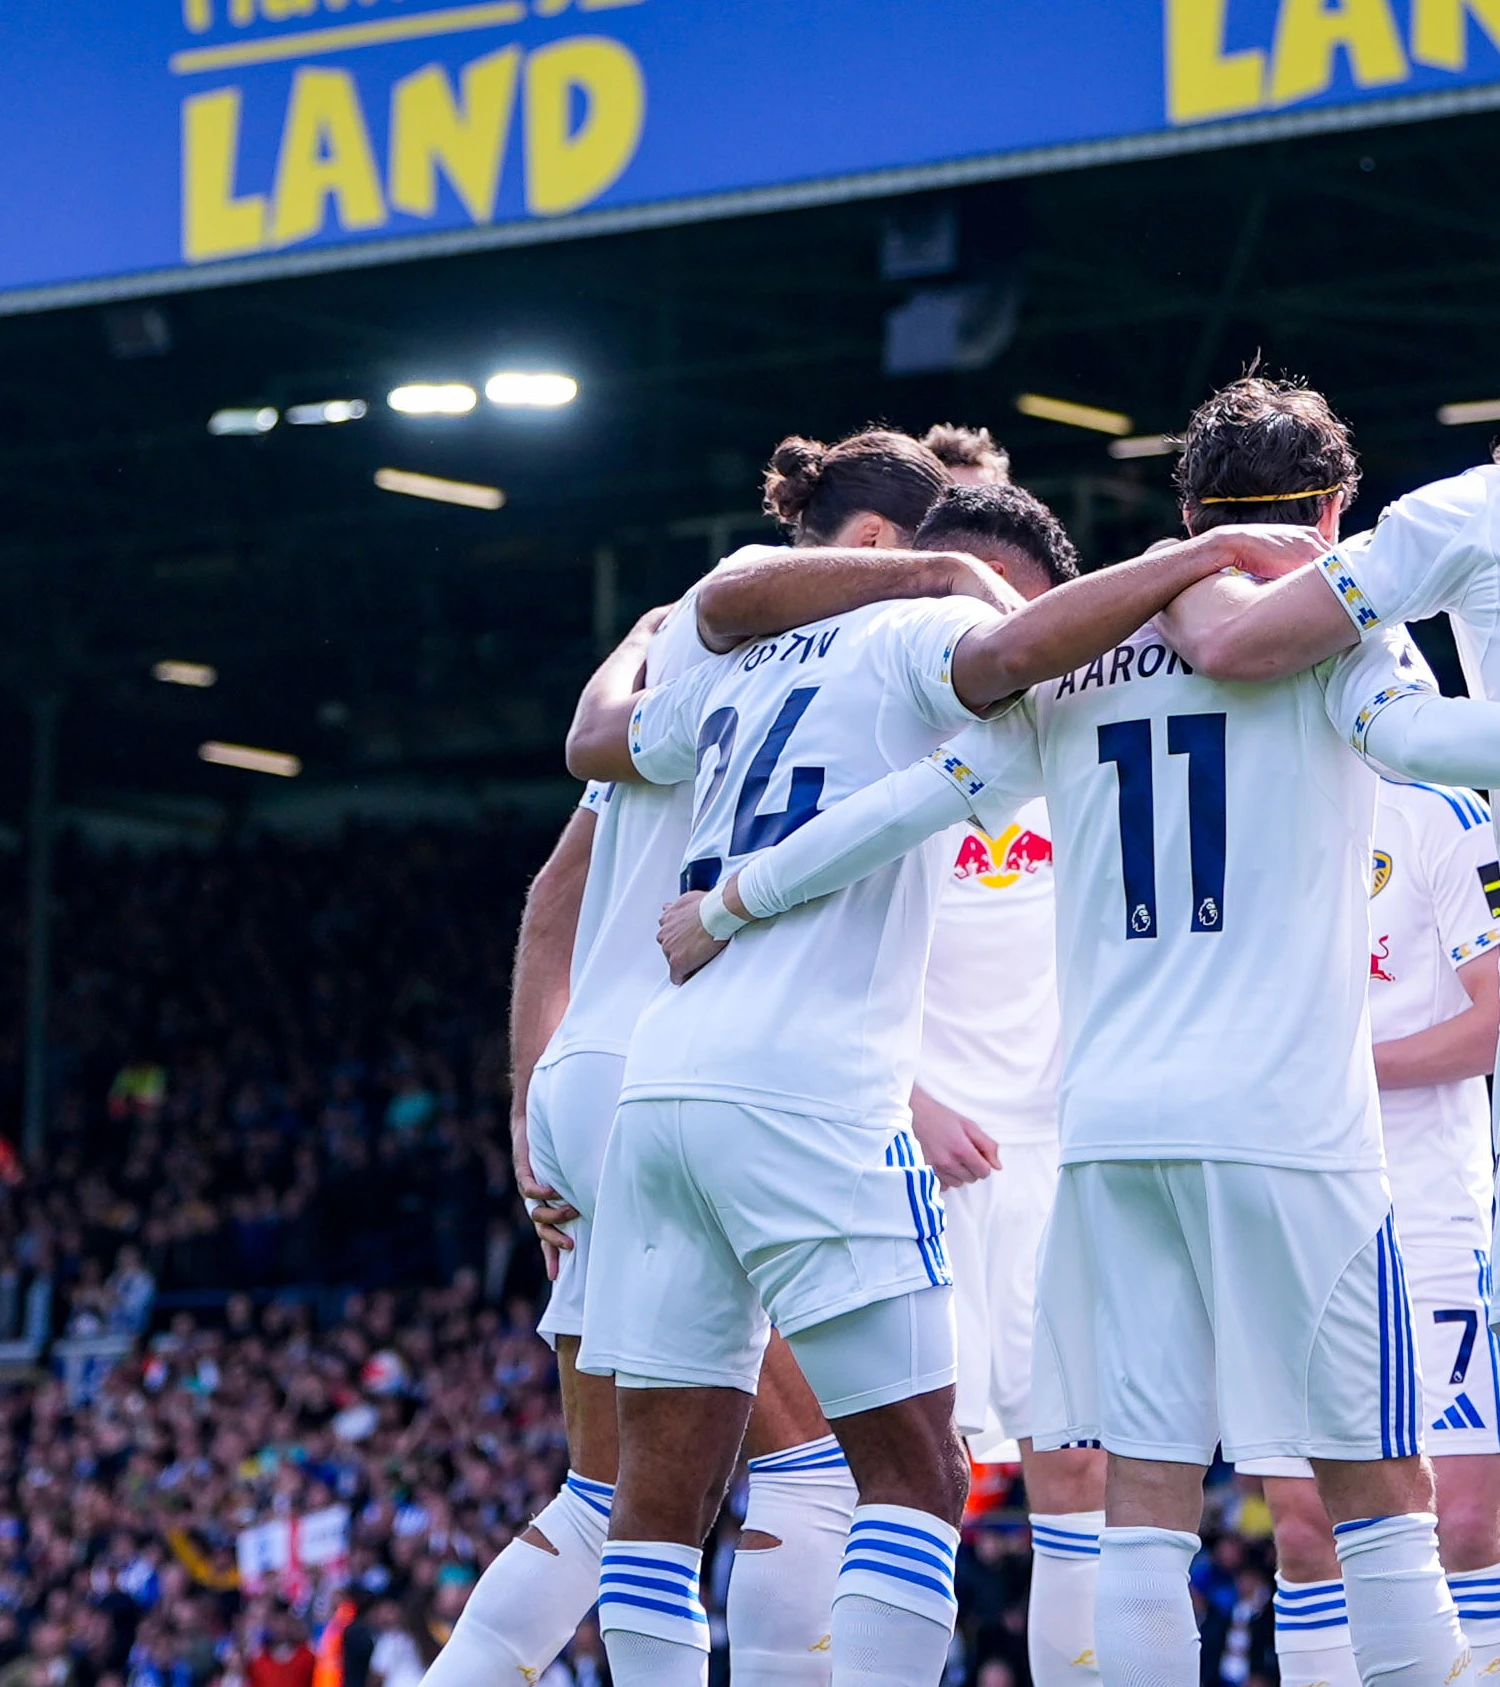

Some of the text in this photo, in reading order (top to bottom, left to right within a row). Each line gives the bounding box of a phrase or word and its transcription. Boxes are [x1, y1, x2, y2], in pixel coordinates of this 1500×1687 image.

[181, 36, 645, 263] LAND
[1055, 644, 1194, 700] AARON
[679, 685, 826, 895] 24
[1097, 712, 1227, 939] 11
[1433, 1309, 1478, 1384] 7
